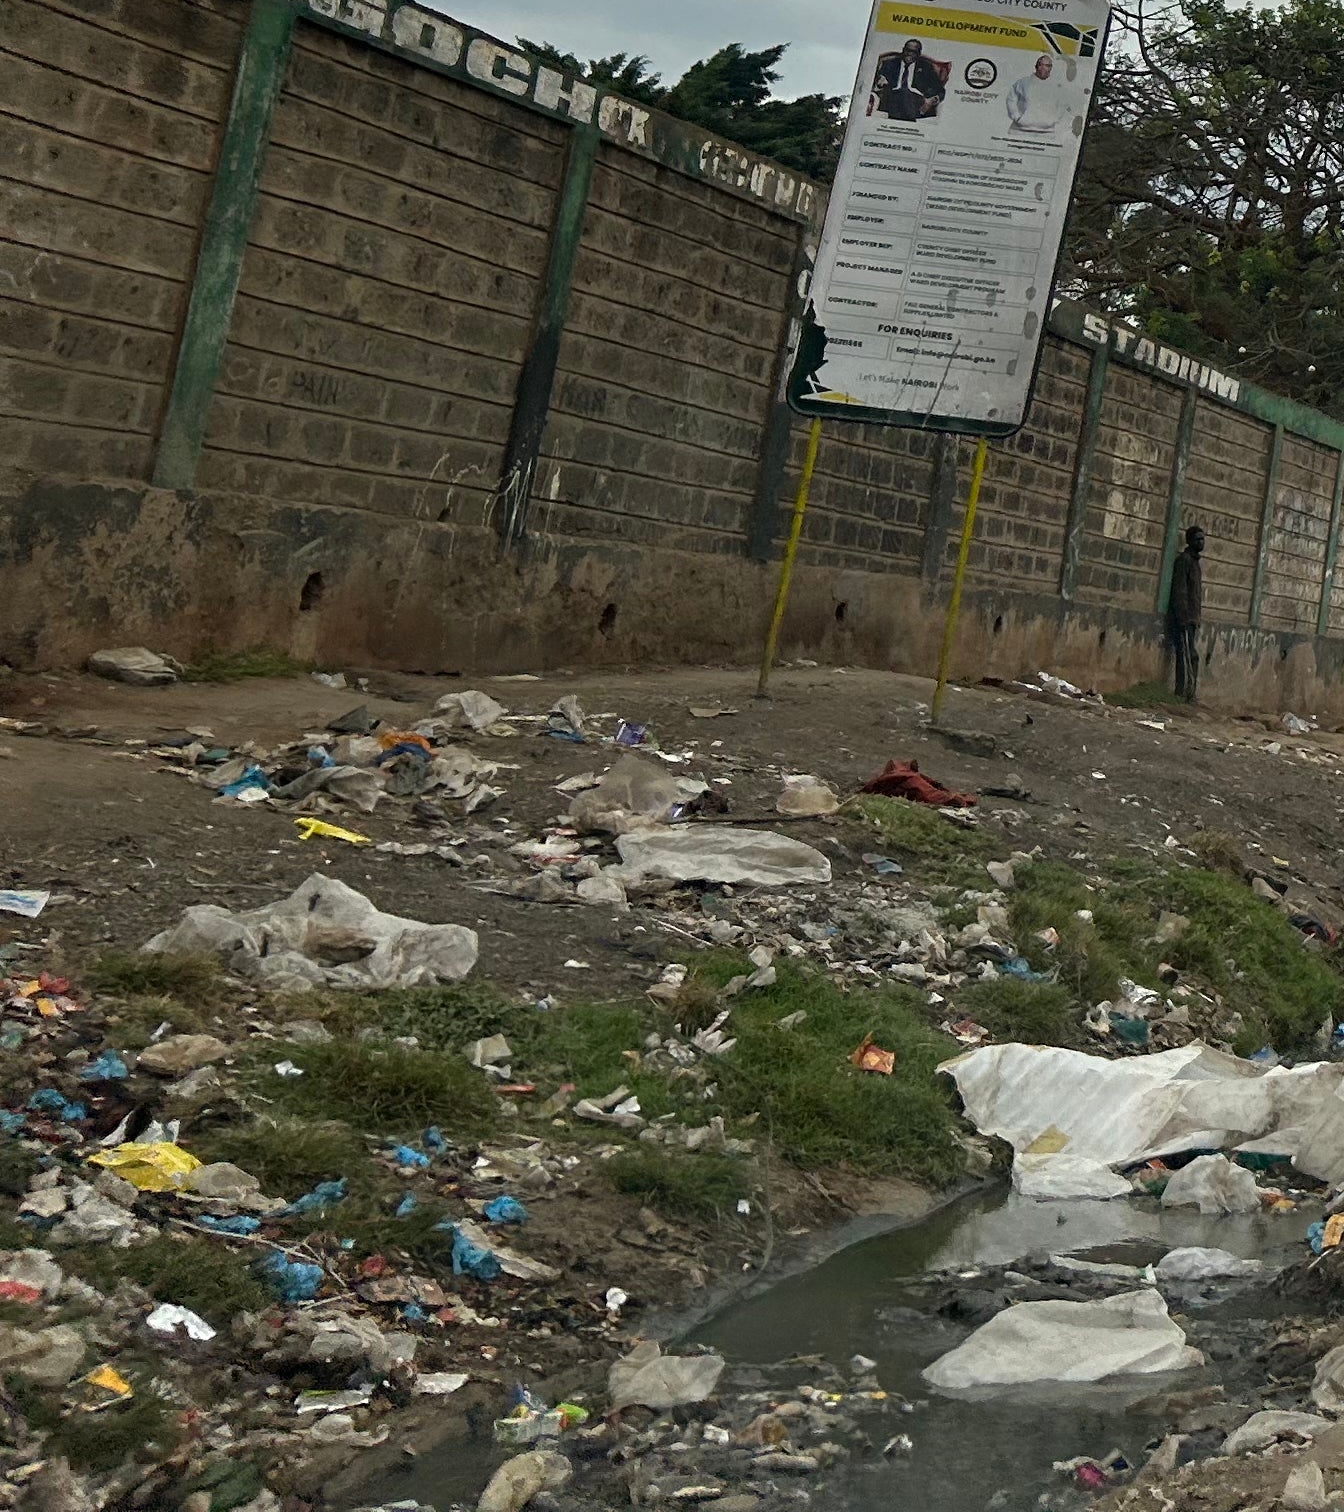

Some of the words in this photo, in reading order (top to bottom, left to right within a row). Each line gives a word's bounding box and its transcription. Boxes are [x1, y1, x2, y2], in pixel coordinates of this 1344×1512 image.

[891, 13, 924, 25] WARD
[924, 17, 997, 34] DEVELOPMENT
[998, 26, 1027, 38] FUND
[953, 88, 981, 97] NAIROBI
[960, 95, 989, 105] COUNTY
[863, 140, 901, 150] CONTRACT
[858, 161, 896, 171] CONTRACT
[877, 324, 898, 334] FOR
[899, 326, 953, 340] ENQUIRIES
[1082, 313, 1241, 402] STADIUM
[901, 377, 937, 388] NAIROBI
